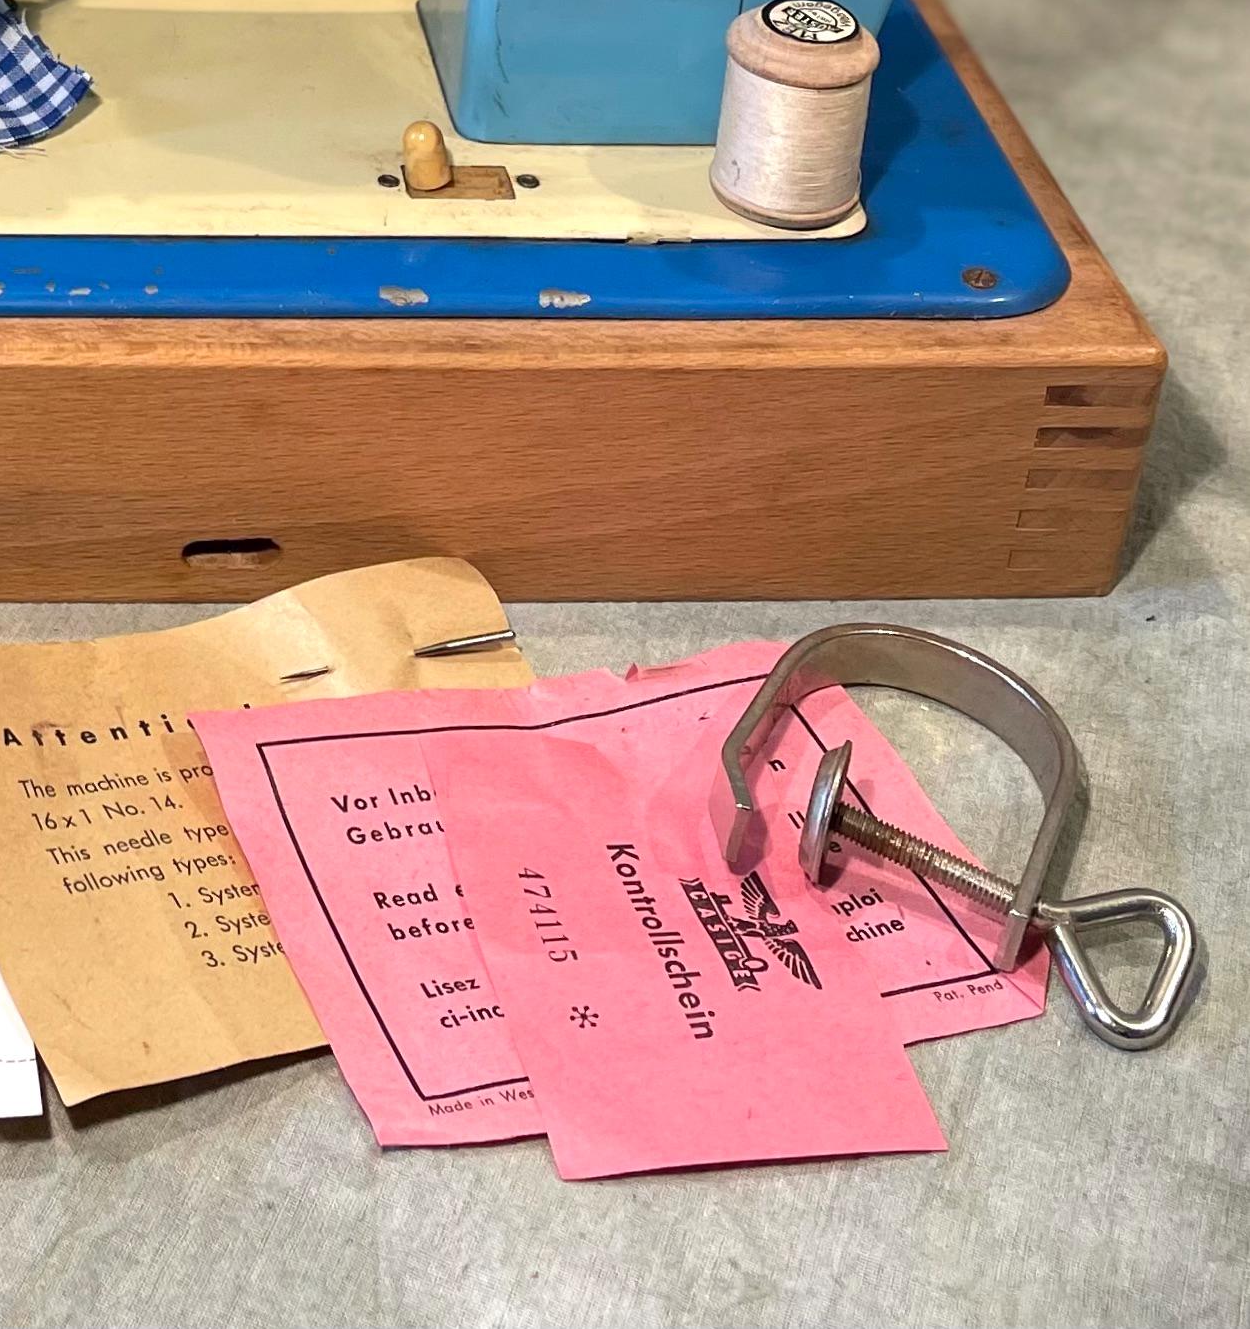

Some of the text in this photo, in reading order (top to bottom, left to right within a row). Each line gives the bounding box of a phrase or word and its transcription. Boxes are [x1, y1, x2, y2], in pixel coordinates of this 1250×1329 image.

[18, 779, 57, 799] The
[66, 772, 150, 798] machine
[153, 767, 172, 783] is
[102, 800, 145, 820] No.
[150, 794, 184, 813] 14.
[330, 784, 436, 813] Vor Inb
[46, 823, 230, 867] This needle type
[62, 853, 237, 896] following types:
[167, 892, 192, 909] 1.
[373, 882, 439, 910] Read
[518, 866, 579, 962] 474115
[184, 920, 209, 939] 2.
[387, 917, 475, 941] before
[605, 843, 716, 1040] Kontrollschein
[689, 890, 751, 980] CASIGE
[201, 950, 226, 968] 3.
[420, 978, 481, 999] Lisez
[933, 989, 965, 1003] Pat.
[428, 1088, 535, 1117] Made in Wes
